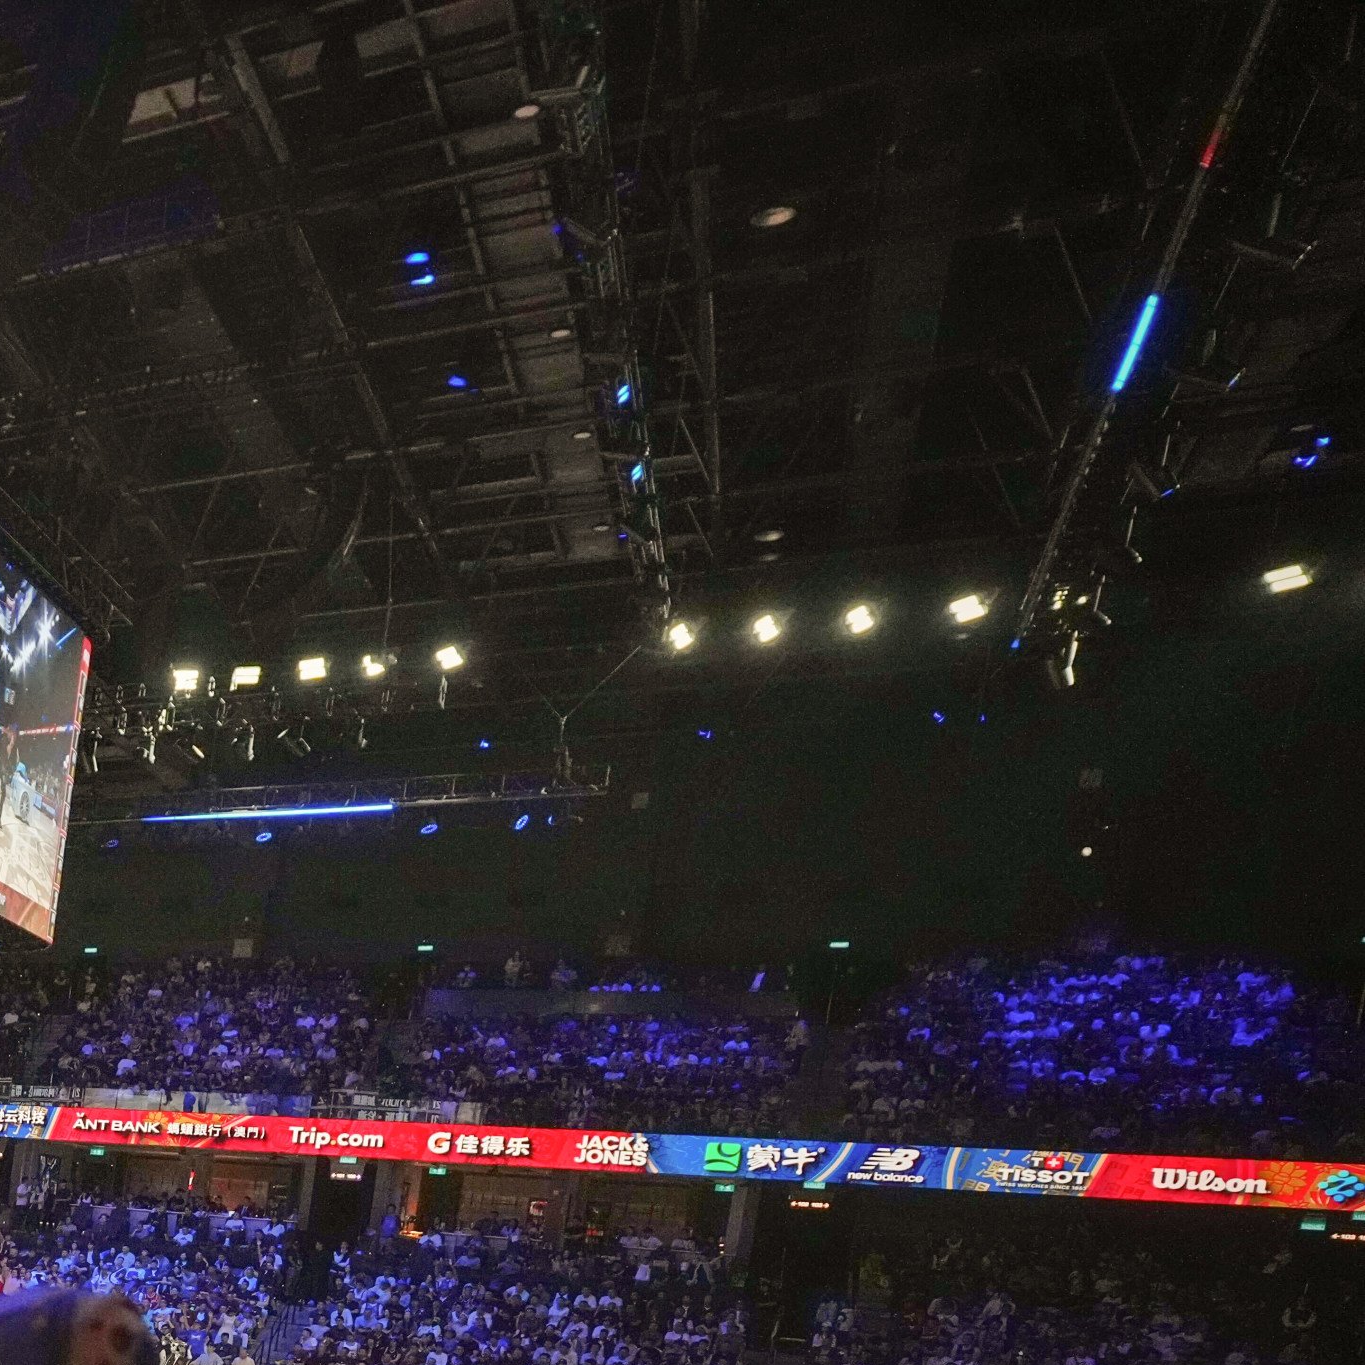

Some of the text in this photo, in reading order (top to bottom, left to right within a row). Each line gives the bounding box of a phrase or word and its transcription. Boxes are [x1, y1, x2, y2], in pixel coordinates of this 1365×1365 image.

[111, 1119, 160, 1134] BANK
[289, 1126, 384, 1149] Trip.com
[454, 1134, 530, 1157] 佳得乐
[575, 1134, 649, 1152] JACK&
[574, 1151, 647, 1167] JONES
[747, 1144, 818, 1175] 蒙牛
[847, 1171, 924, 1184] new balance
[1000, 1168, 1091, 1185] TISSOT
[1152, 1167, 1271, 1194] Wilson
